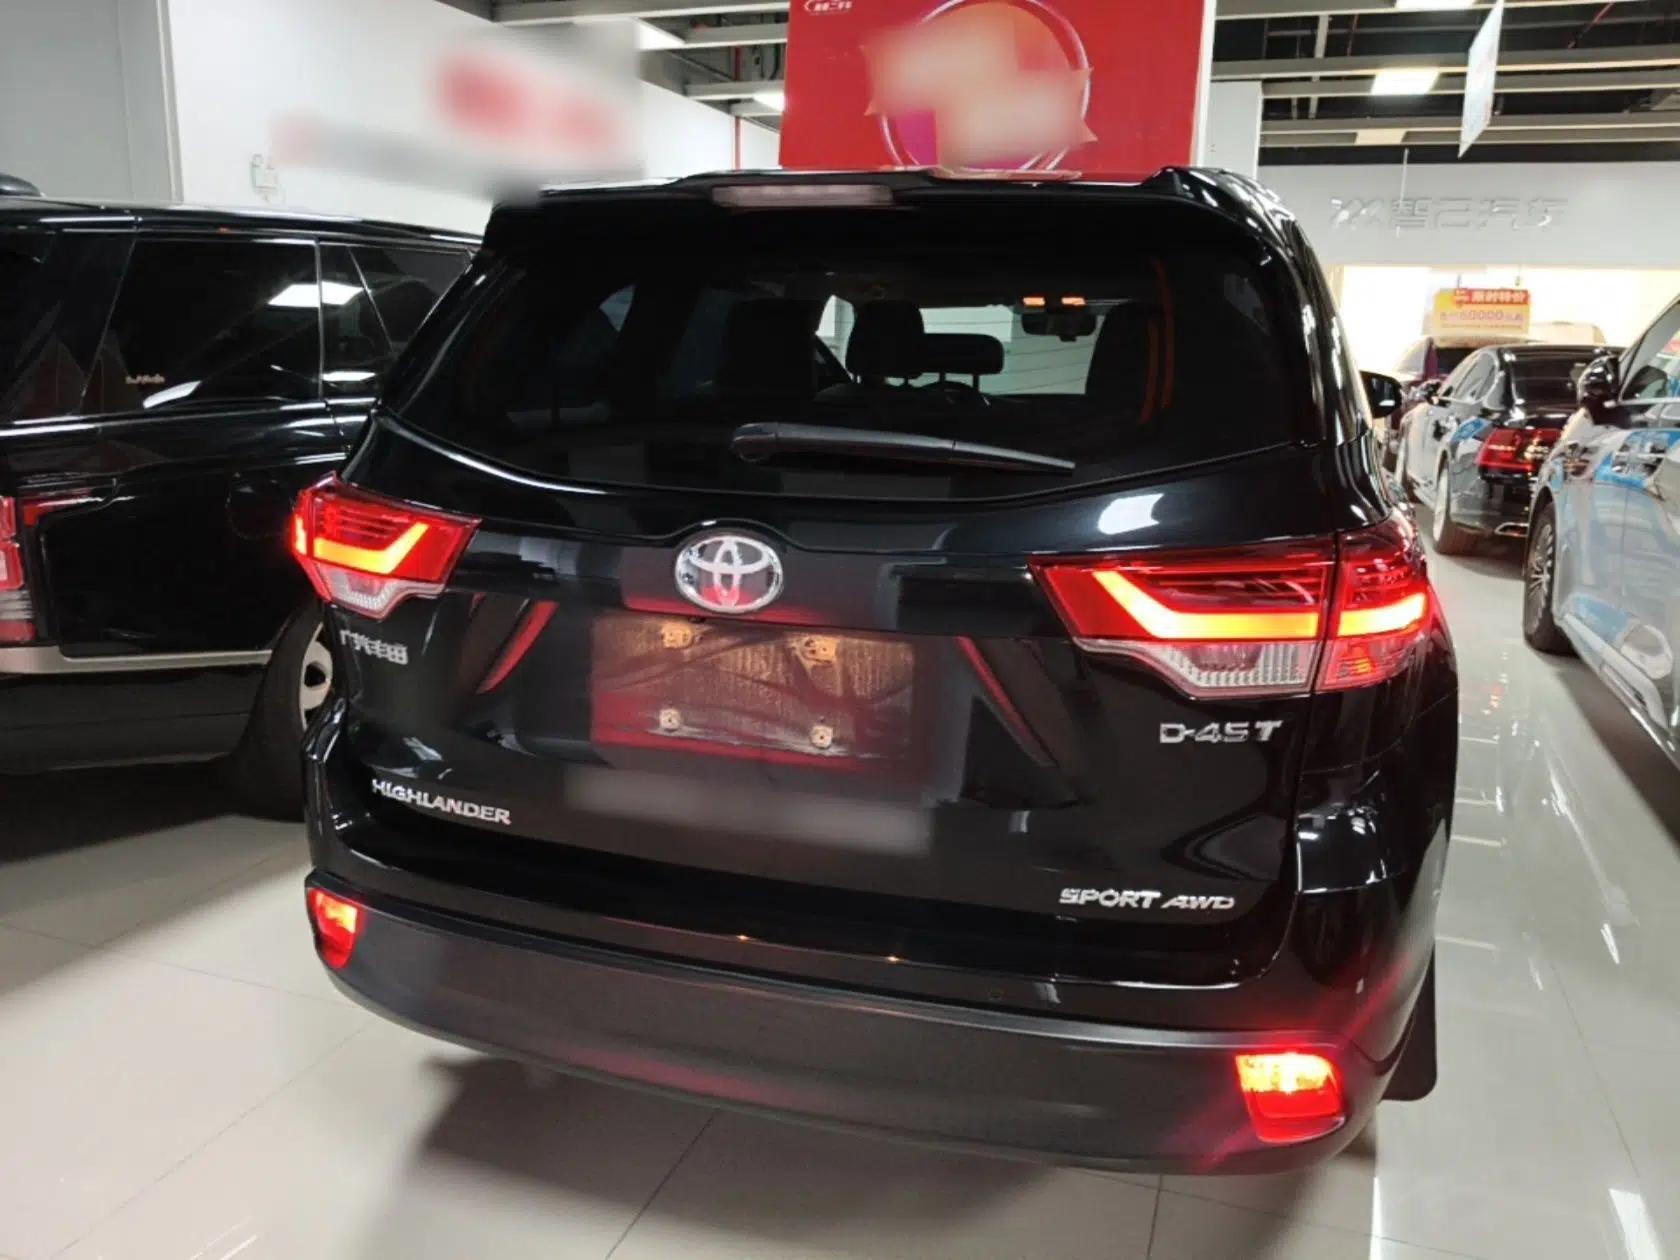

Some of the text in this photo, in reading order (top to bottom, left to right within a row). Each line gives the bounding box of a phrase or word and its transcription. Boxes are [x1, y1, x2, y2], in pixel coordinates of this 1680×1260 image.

[372, 779, 511, 825] HIGHLANDER
[1059, 888, 1235, 910] SPORT AWD
